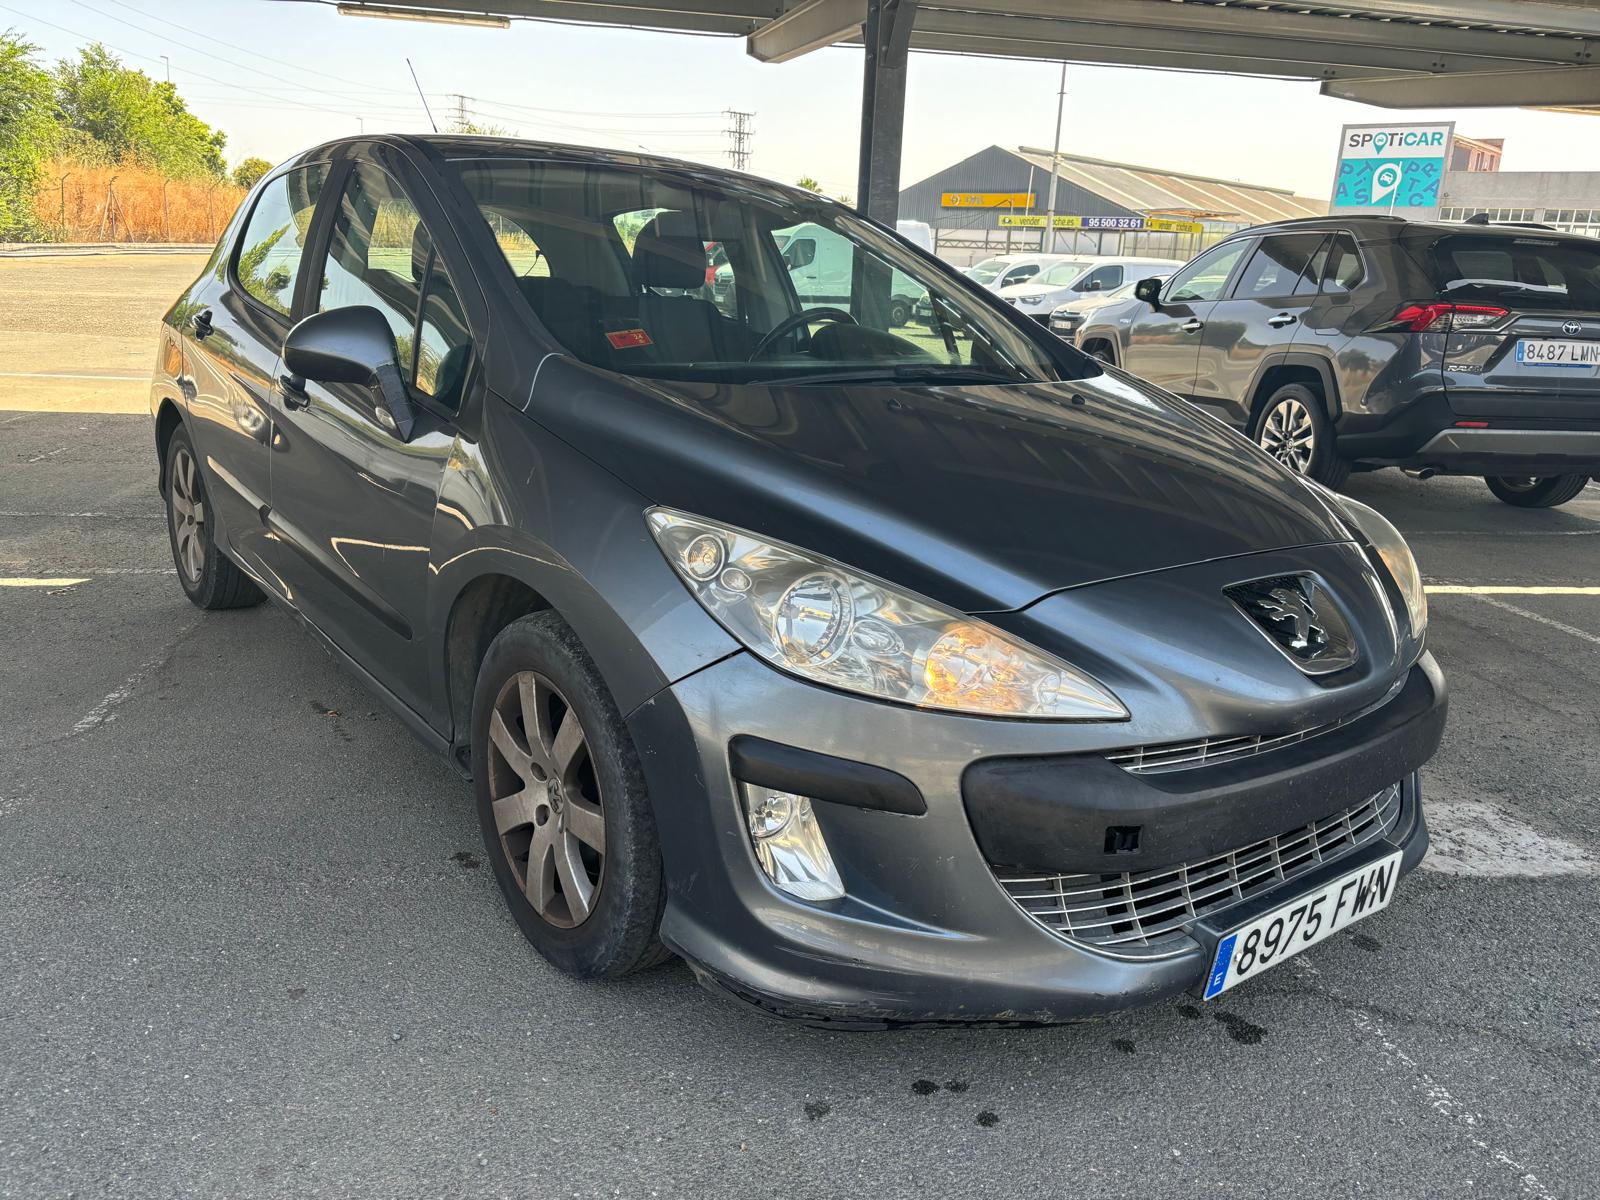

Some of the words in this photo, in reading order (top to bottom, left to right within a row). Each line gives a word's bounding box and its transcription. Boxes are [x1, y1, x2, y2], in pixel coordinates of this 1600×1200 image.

[1088, 218, 1100, 227] 95
[1100, 218, 1117, 227] 500
[1118, 218, 1129, 228] 32
[1130, 219, 1141, 228] 61
[1527, 344, 1566, 361] 8487
[1571, 345, 1599, 361] LMN
[1236, 894, 1327, 976] 8975
[1330, 860, 1396, 929] FWN
